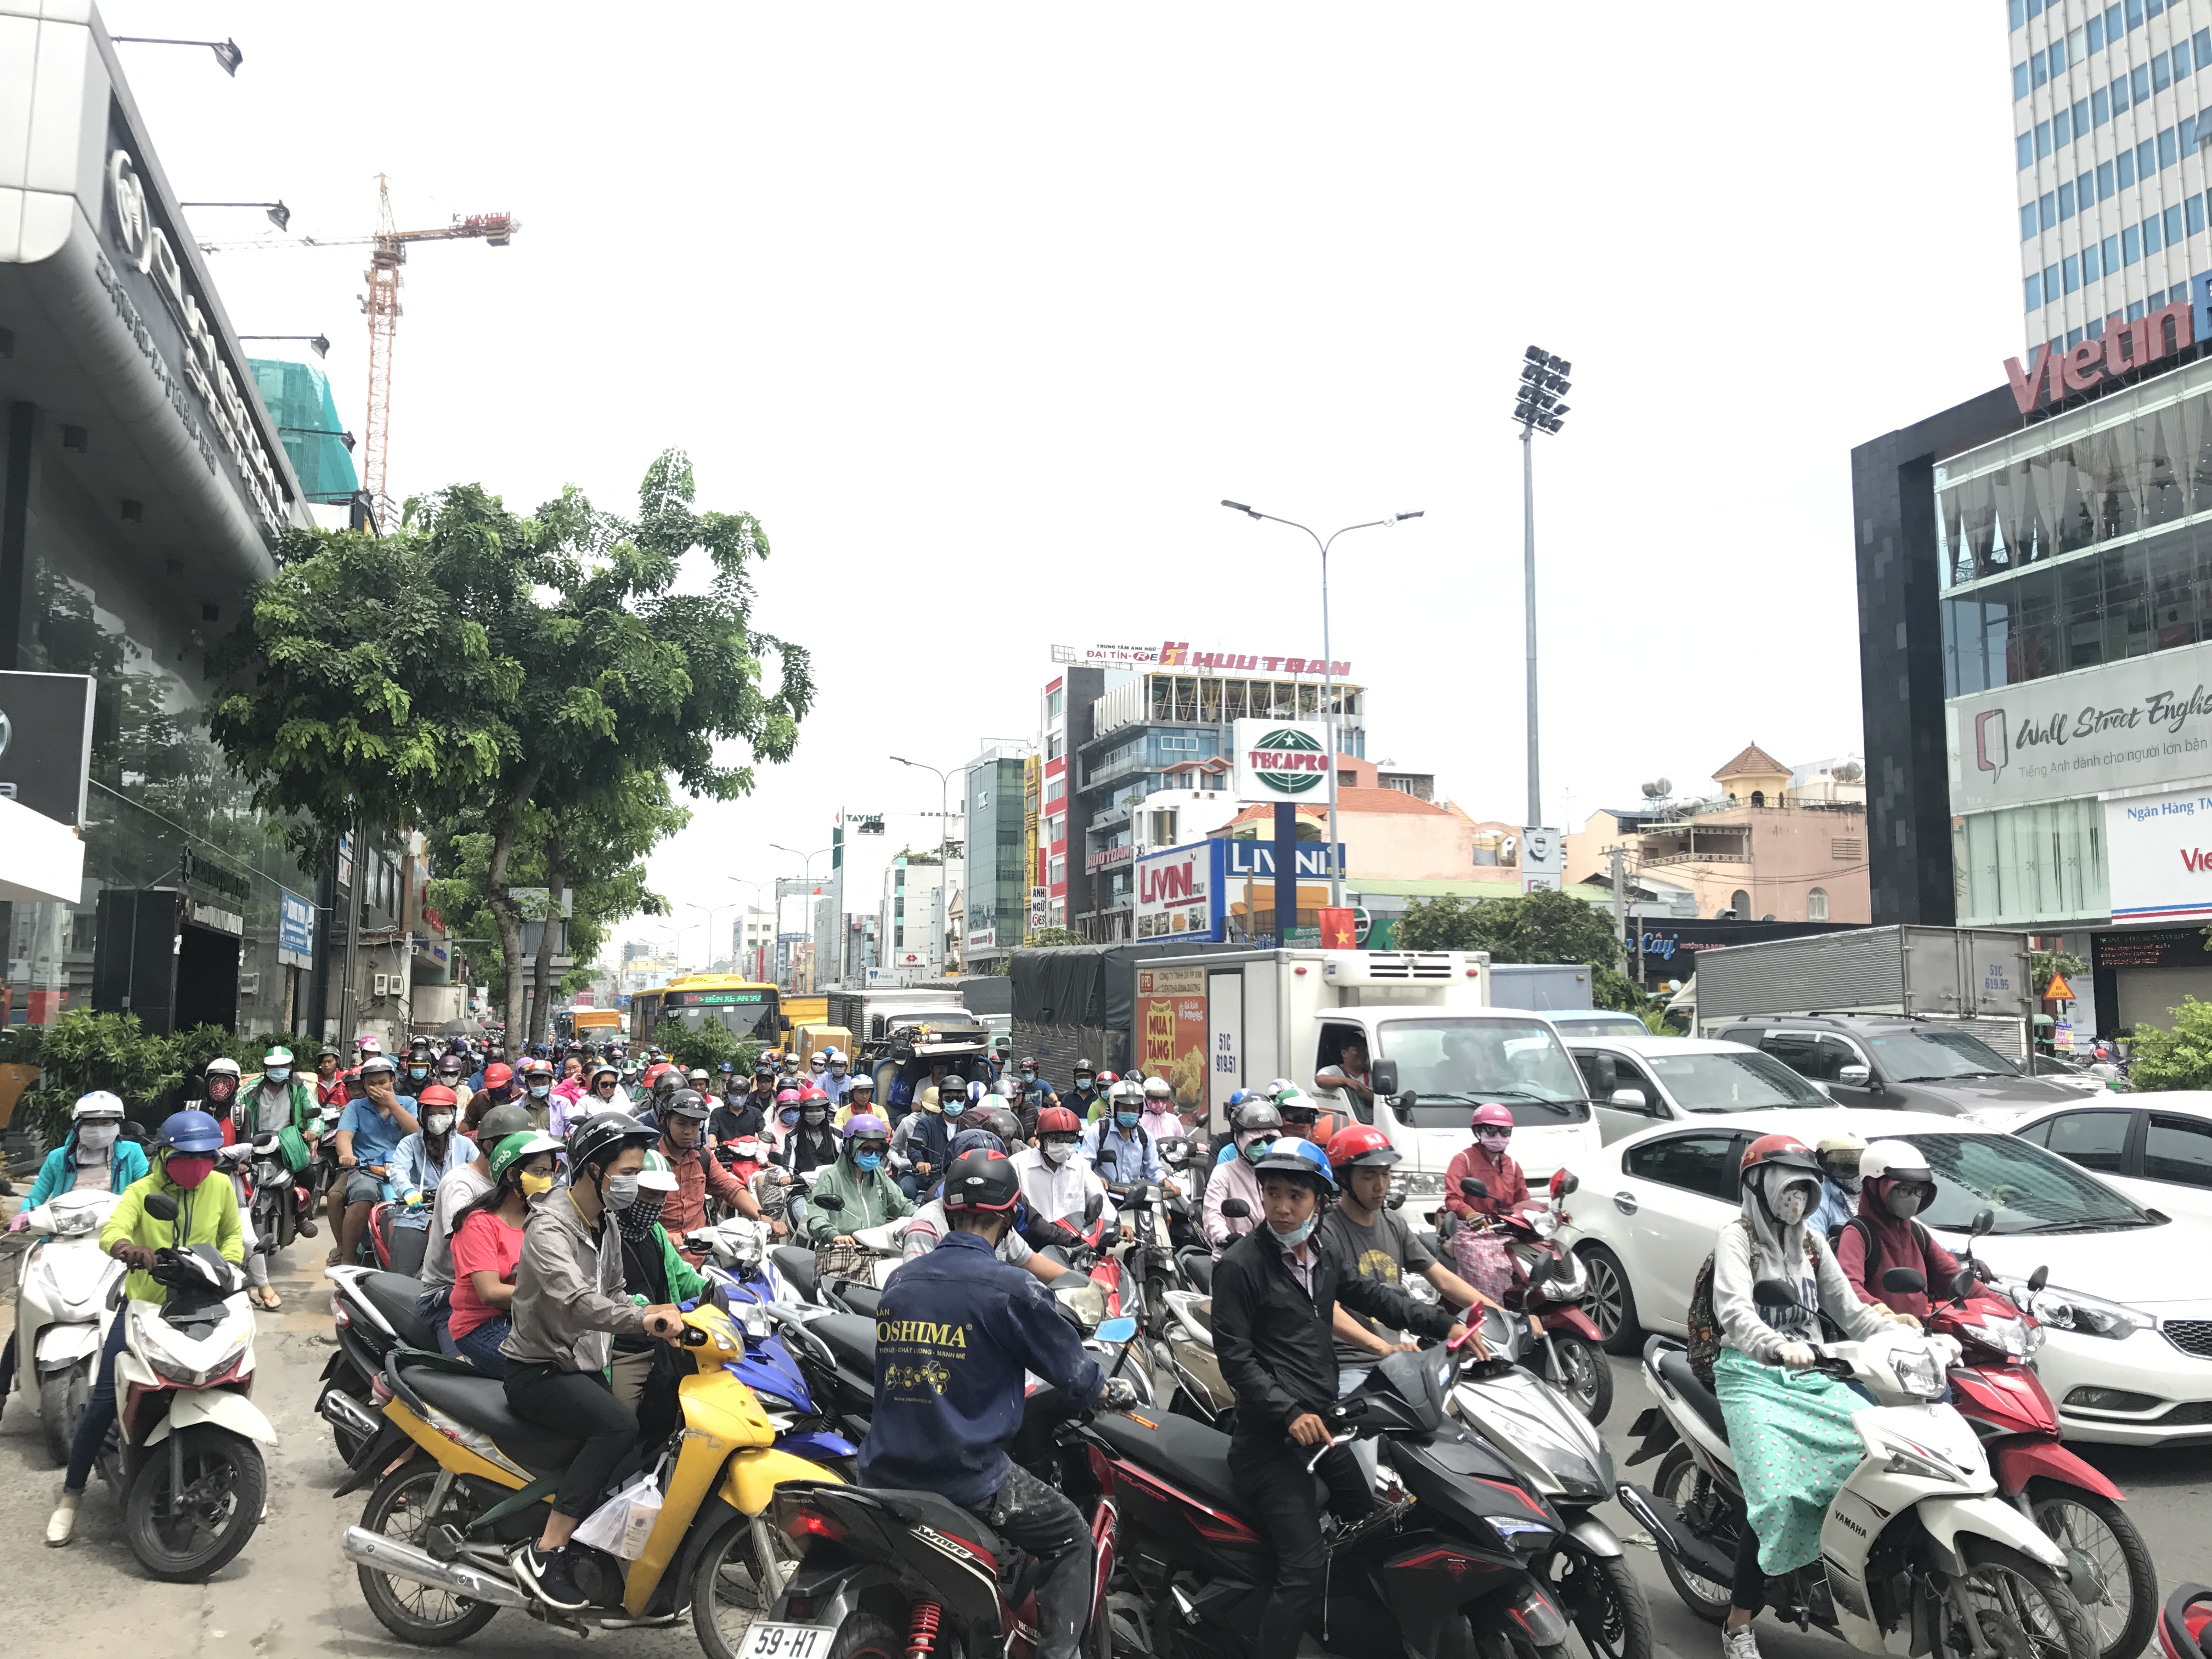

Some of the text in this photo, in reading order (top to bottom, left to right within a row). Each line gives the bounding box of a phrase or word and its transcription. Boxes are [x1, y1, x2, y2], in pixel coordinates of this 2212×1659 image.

[2003, 274, 2212, 414] Vietin
[2016, 713, 2070, 749] Wall
[2072, 706, 2146, 738] Street
[1248, 751, 1329, 771] TECAPRO
[2050, 760, 2070, 774] Anh
[2073, 755, 2101, 770] dành
[2103, 752, 2124, 765] cho
[2128, 743, 2160, 762] người
[2164, 742, 2181, 755] lớn
[2185, 738, 2208, 753] bận
[2128, 806, 2158, 821] Ngân
[2162, 801, 2194, 816] Hàng
[1232, 843, 1326, 874] LIVNI
[1032, 888, 1045, 898] ANH
[1032, 913, 1045, 926] RES
[1989, 964, 2003, 977] 51C
[1985, 978, 2009, 990] 619.95
[1149, 1015, 1173, 1036] MUA 1
[1147, 1036, 1175, 1063] TẶNG 1
[1218, 1032, 1231, 1052] 51C
[1216, 1054, 1237, 1074] 919.51
[492, 1150, 511, 1172] Grab
[876, 1321, 967, 1348] OSHIMA
[783, 1492, 815, 1504] HONDA
[1835, 1510, 1867, 1538] YAMAHA
[754, 1627, 819, 1658] 59-H1
